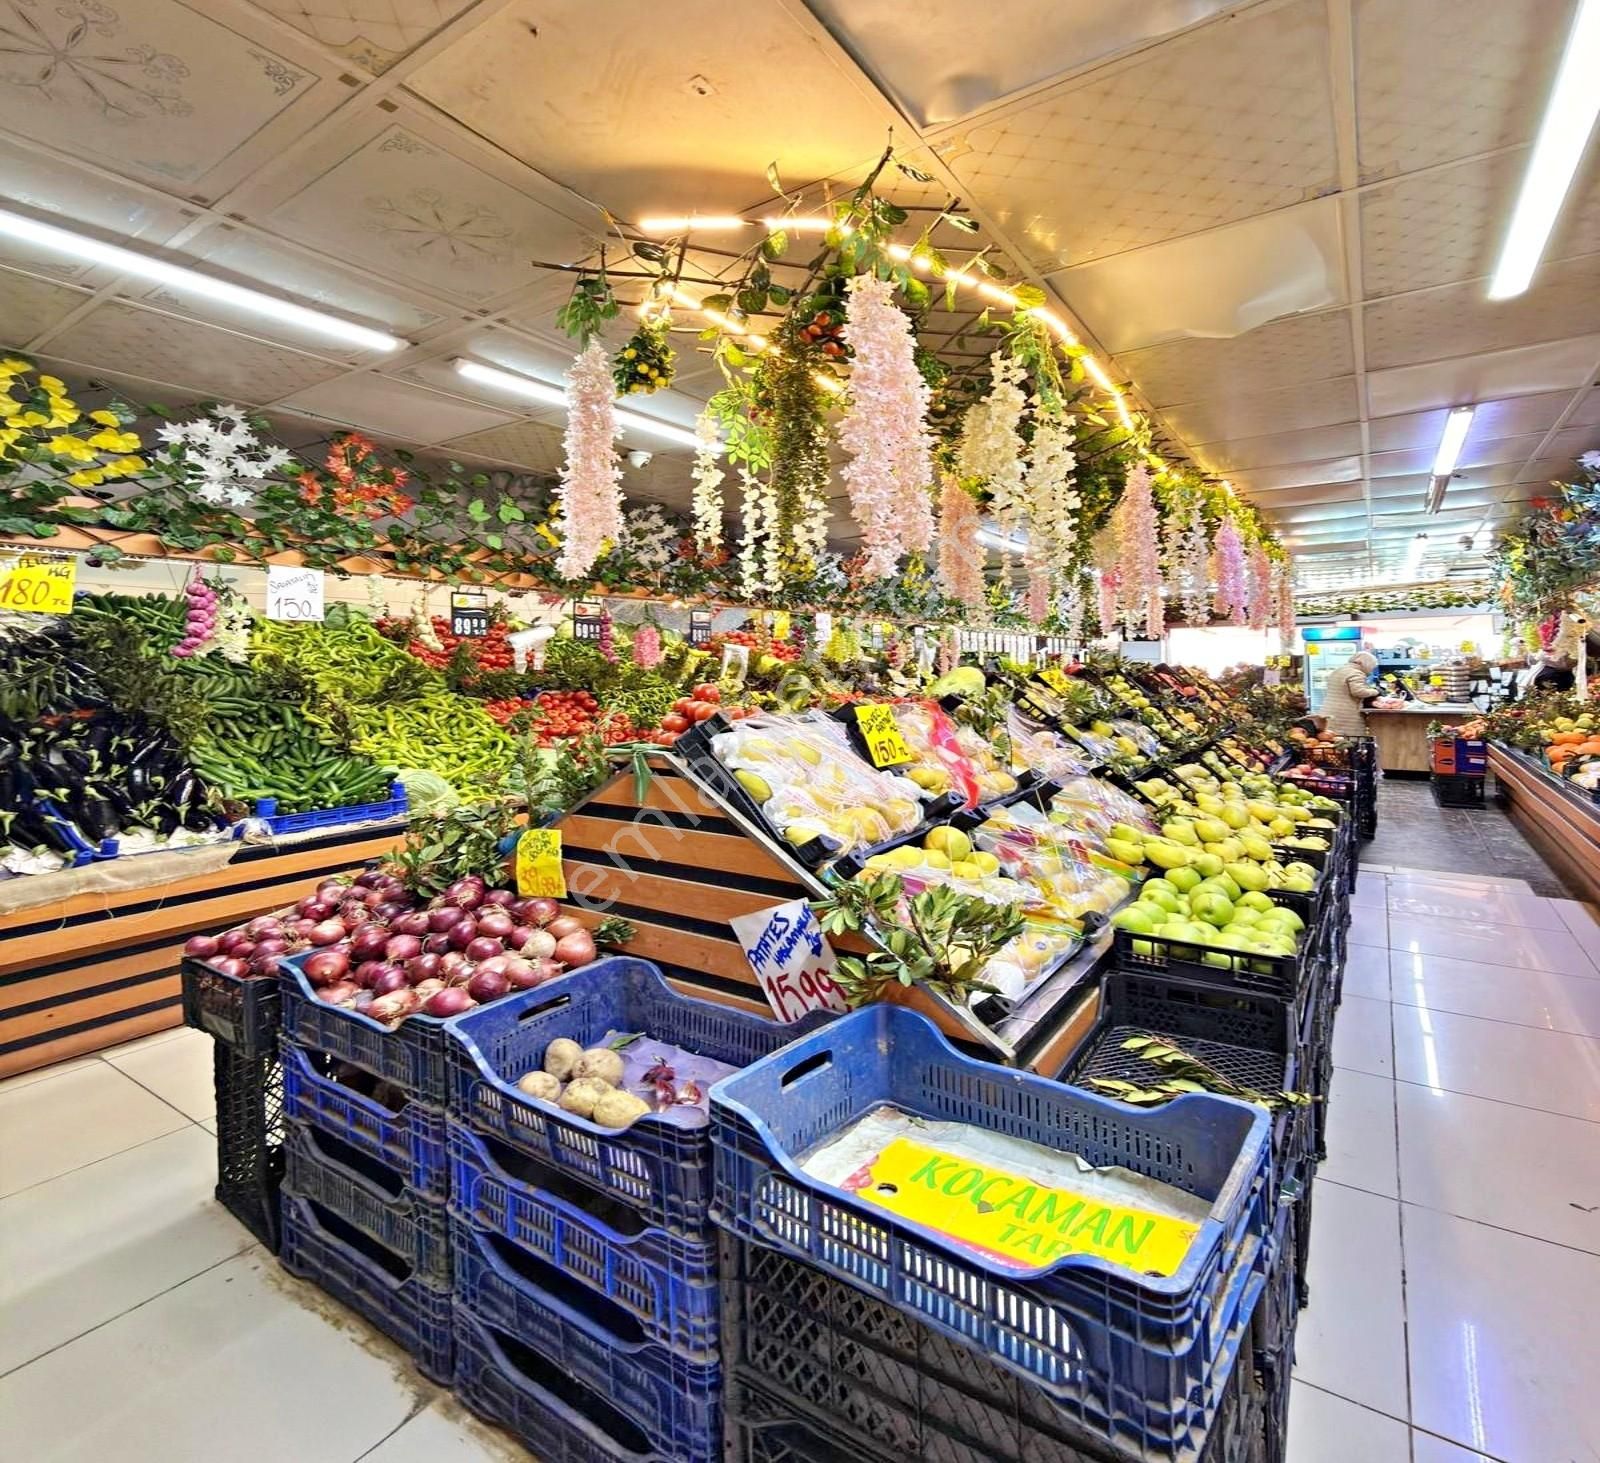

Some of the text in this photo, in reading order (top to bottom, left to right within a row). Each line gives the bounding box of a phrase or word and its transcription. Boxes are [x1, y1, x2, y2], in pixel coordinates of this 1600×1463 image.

[0, 578, 50, 605] 180
[874, 738, 897, 762] 150
[747, 911, 790, 975] PATATES
[910, 1155, 1156, 1254] KOCAMAN
